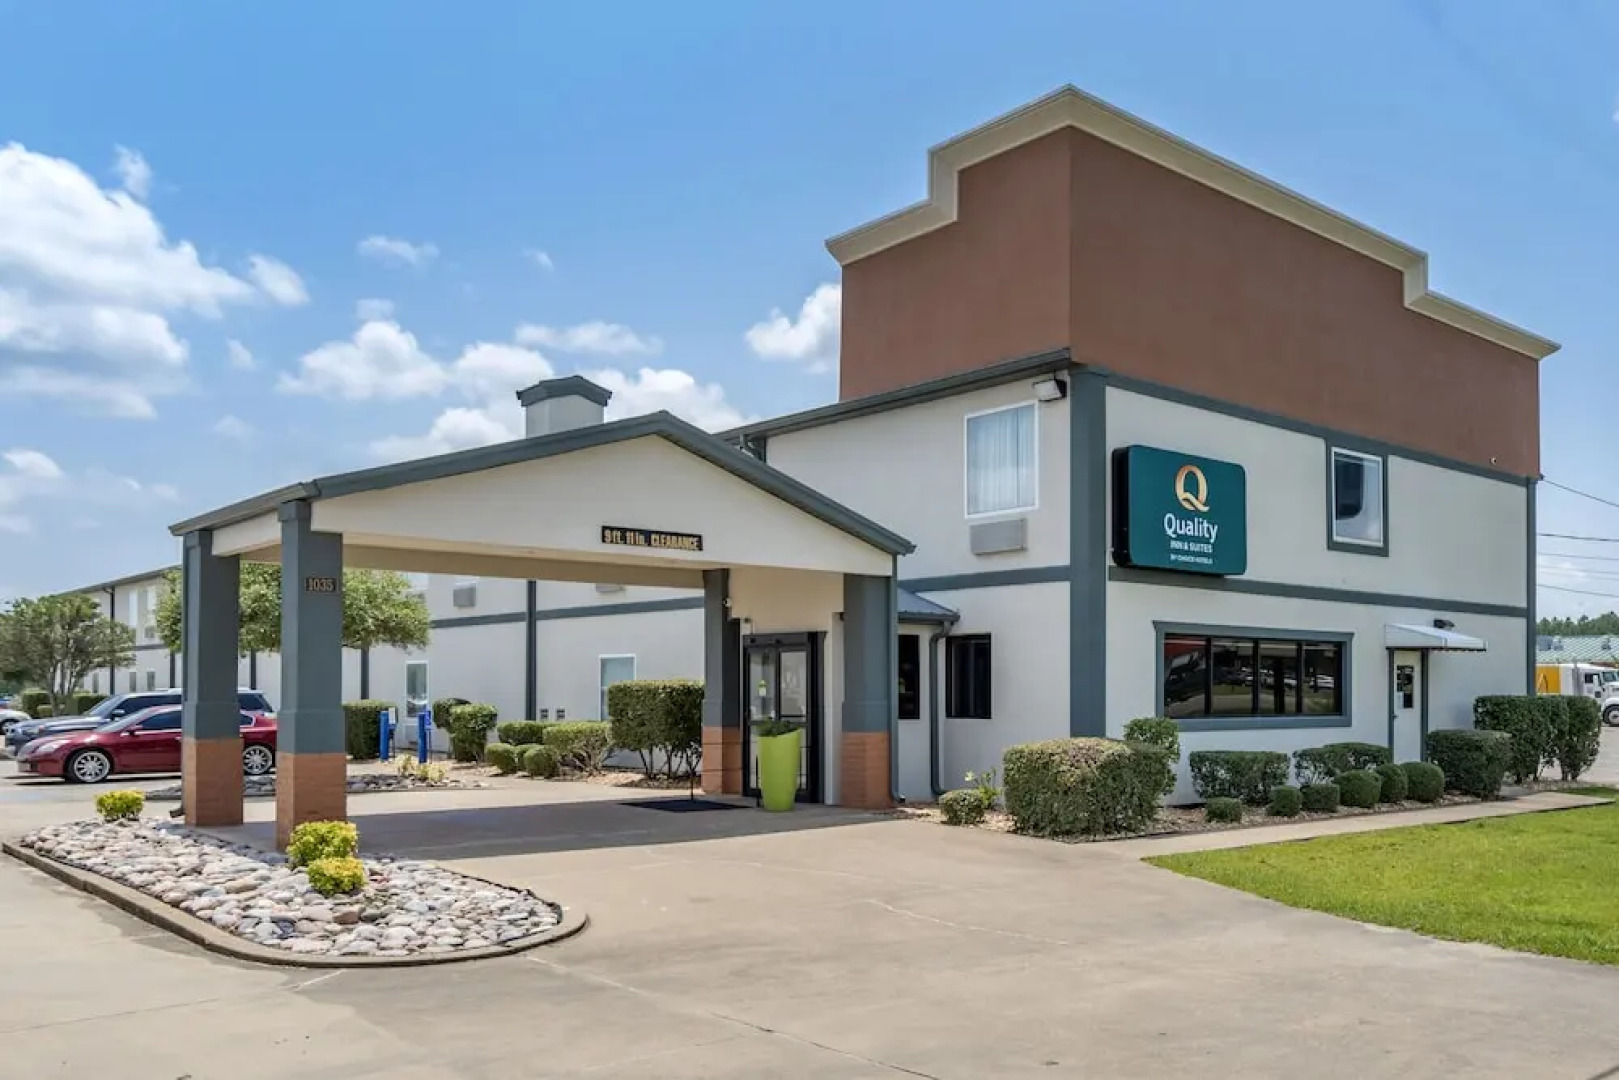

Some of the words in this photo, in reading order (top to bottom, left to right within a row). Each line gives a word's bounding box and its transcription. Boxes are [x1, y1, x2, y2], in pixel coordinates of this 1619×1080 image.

[1175, 464, 1210, 512] Q
[1163, 512, 1219, 543] Quality
[651, 533, 699, 550] CLEARANCE
[1190, 542, 1213, 553] SUITES
[308, 578, 334, 591] 1035
